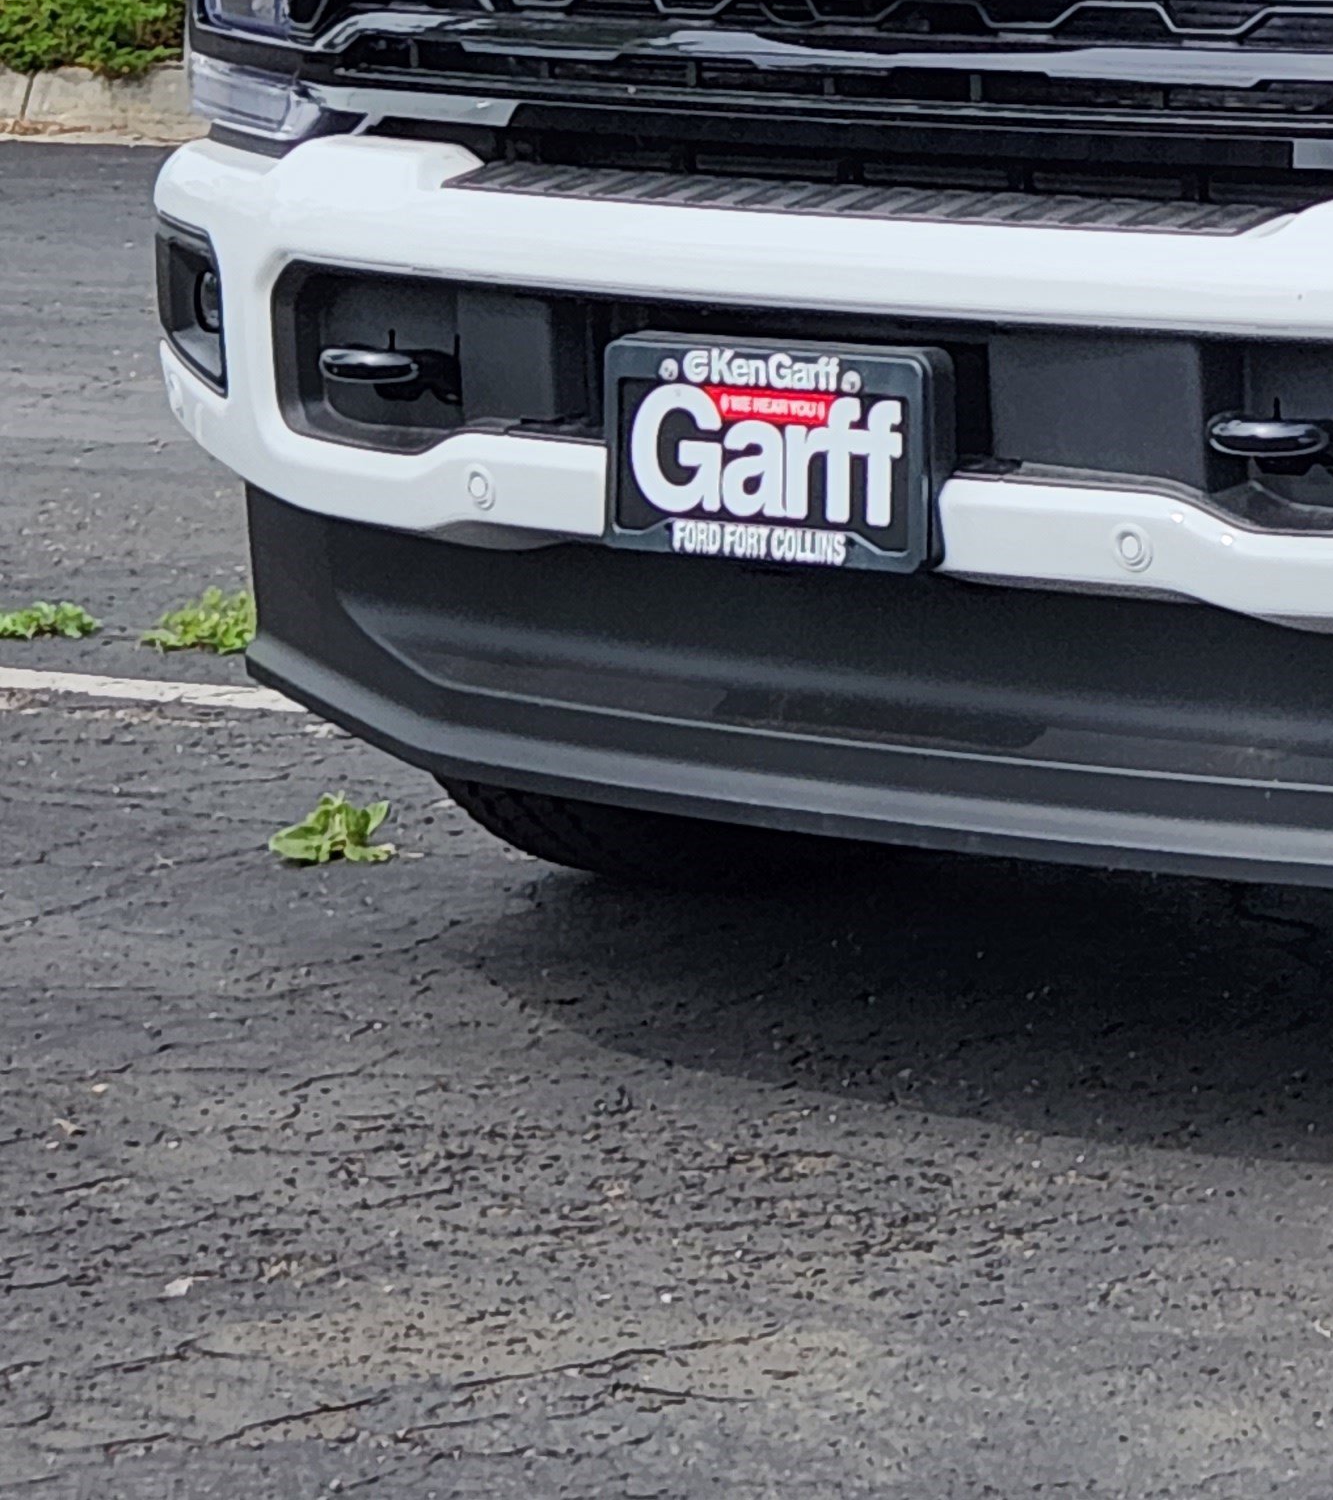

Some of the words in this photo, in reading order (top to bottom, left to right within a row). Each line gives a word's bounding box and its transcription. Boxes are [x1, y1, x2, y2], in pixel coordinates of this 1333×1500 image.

[710, 348, 767, 388] Ken
[767, 352, 841, 392] Garff
[630, 383, 904, 528] Garff
[672, 519, 721, 554] FORD
[722, 523, 770, 559] FORT
[770, 528, 847, 566] COLLINS
